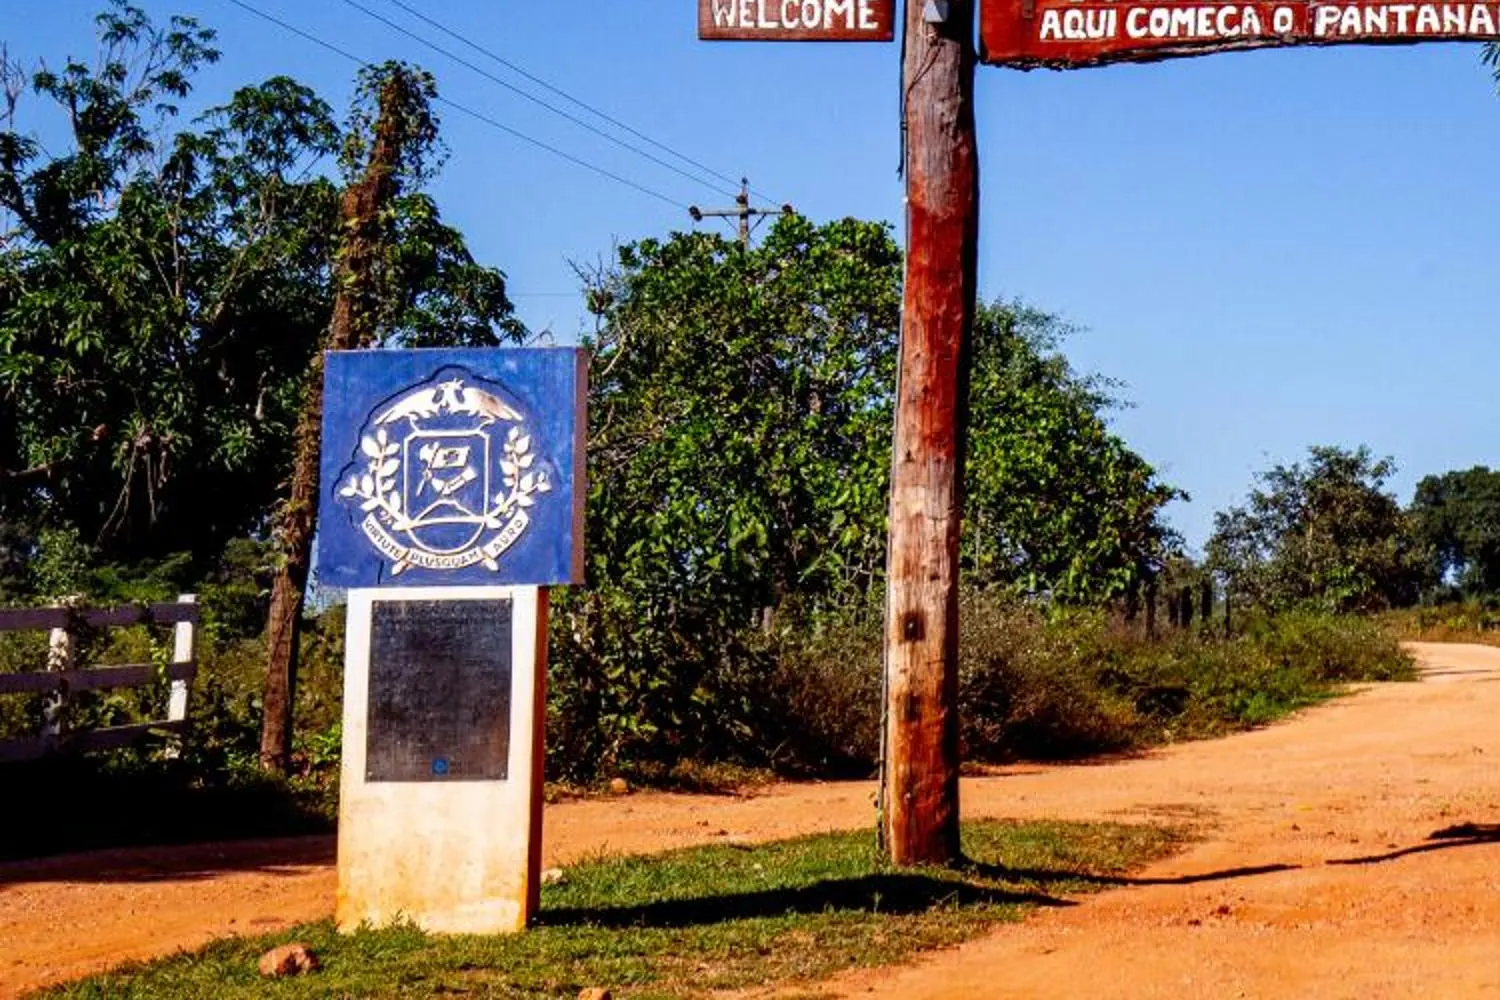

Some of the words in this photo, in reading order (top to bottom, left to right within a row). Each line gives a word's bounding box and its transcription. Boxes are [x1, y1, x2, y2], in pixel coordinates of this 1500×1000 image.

[1040, 8, 1117, 40] AQUI
[1273, 6, 1294, 33] O
[493, 518, 523, 552] AURO
